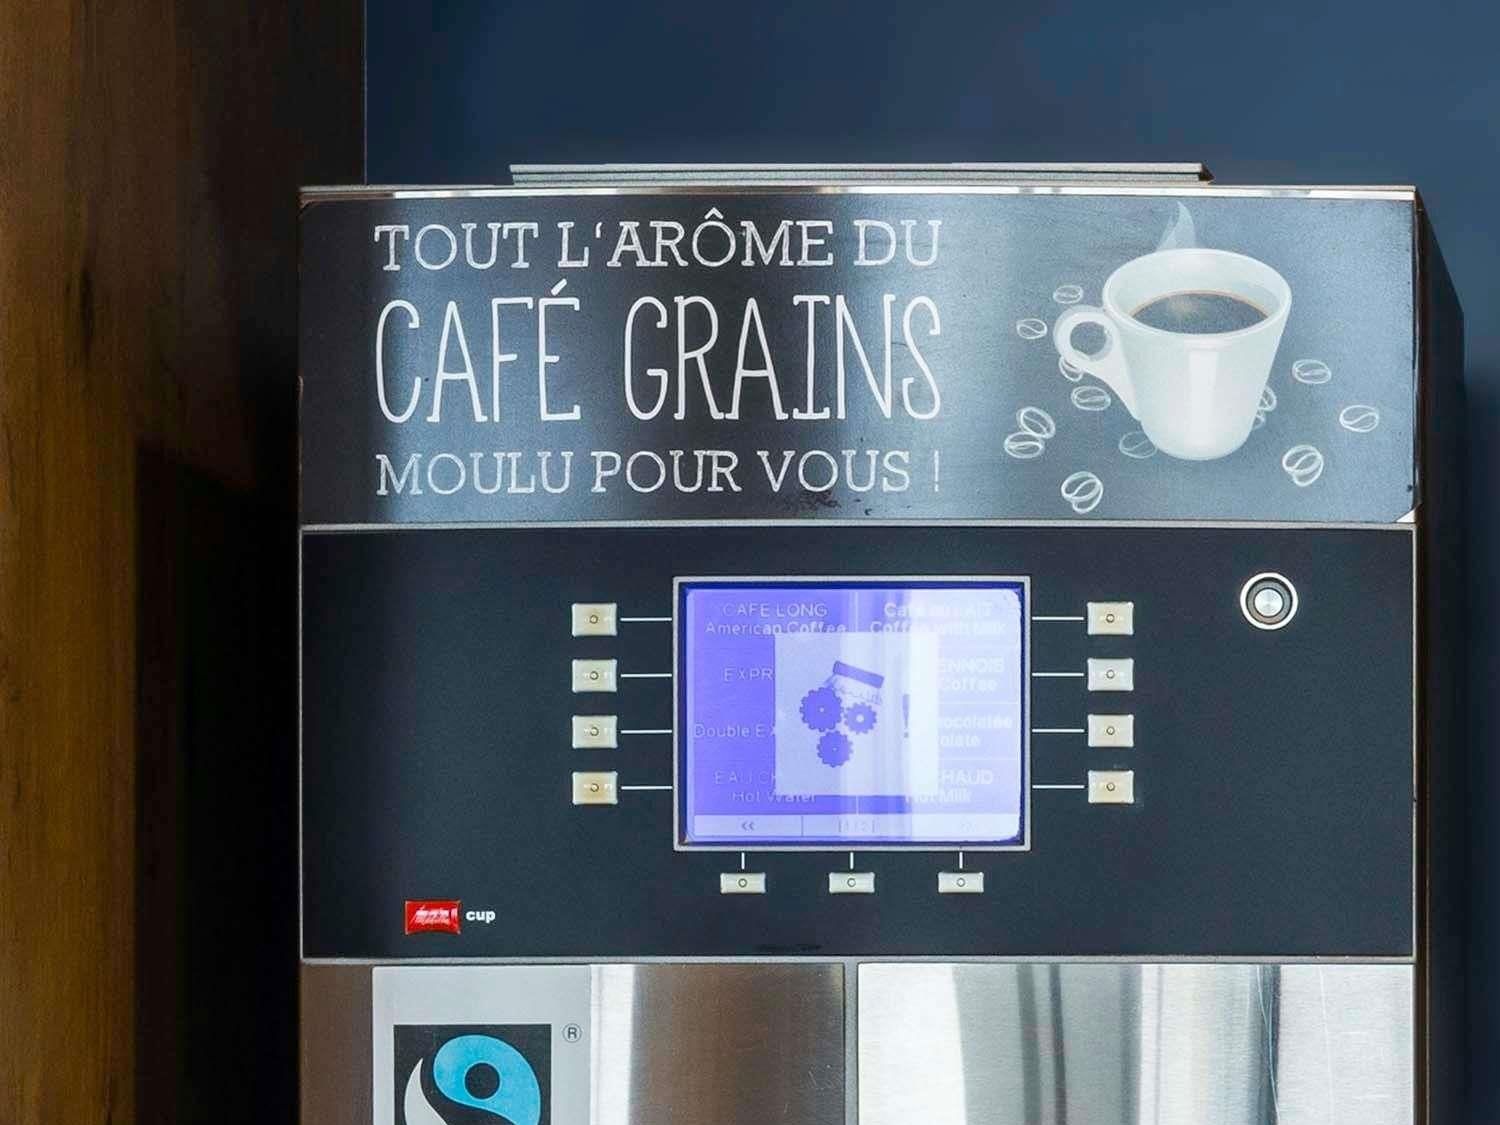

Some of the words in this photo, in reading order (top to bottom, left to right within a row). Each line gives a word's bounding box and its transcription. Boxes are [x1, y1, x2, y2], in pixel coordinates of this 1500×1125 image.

[374, 222, 538, 271] TOUT
[557, 207, 834, 268] L'ARÔME
[854, 219, 942, 266] DU
[375, 279, 581, 424] CAFÉ
[624, 294, 942, 421] GRAINS
[375, 451, 573, 496] MOULU
[591, 452, 742, 493] POUR
[758, 451, 911, 492] VOUS
[723, 602, 770, 617] CAFE
[776, 602, 828, 618] LONG
[705, 621, 783, 636] American
[724, 668, 774, 682] EXPR
[693, 723, 752, 739] Double
[465, 911, 496, 924] cup
